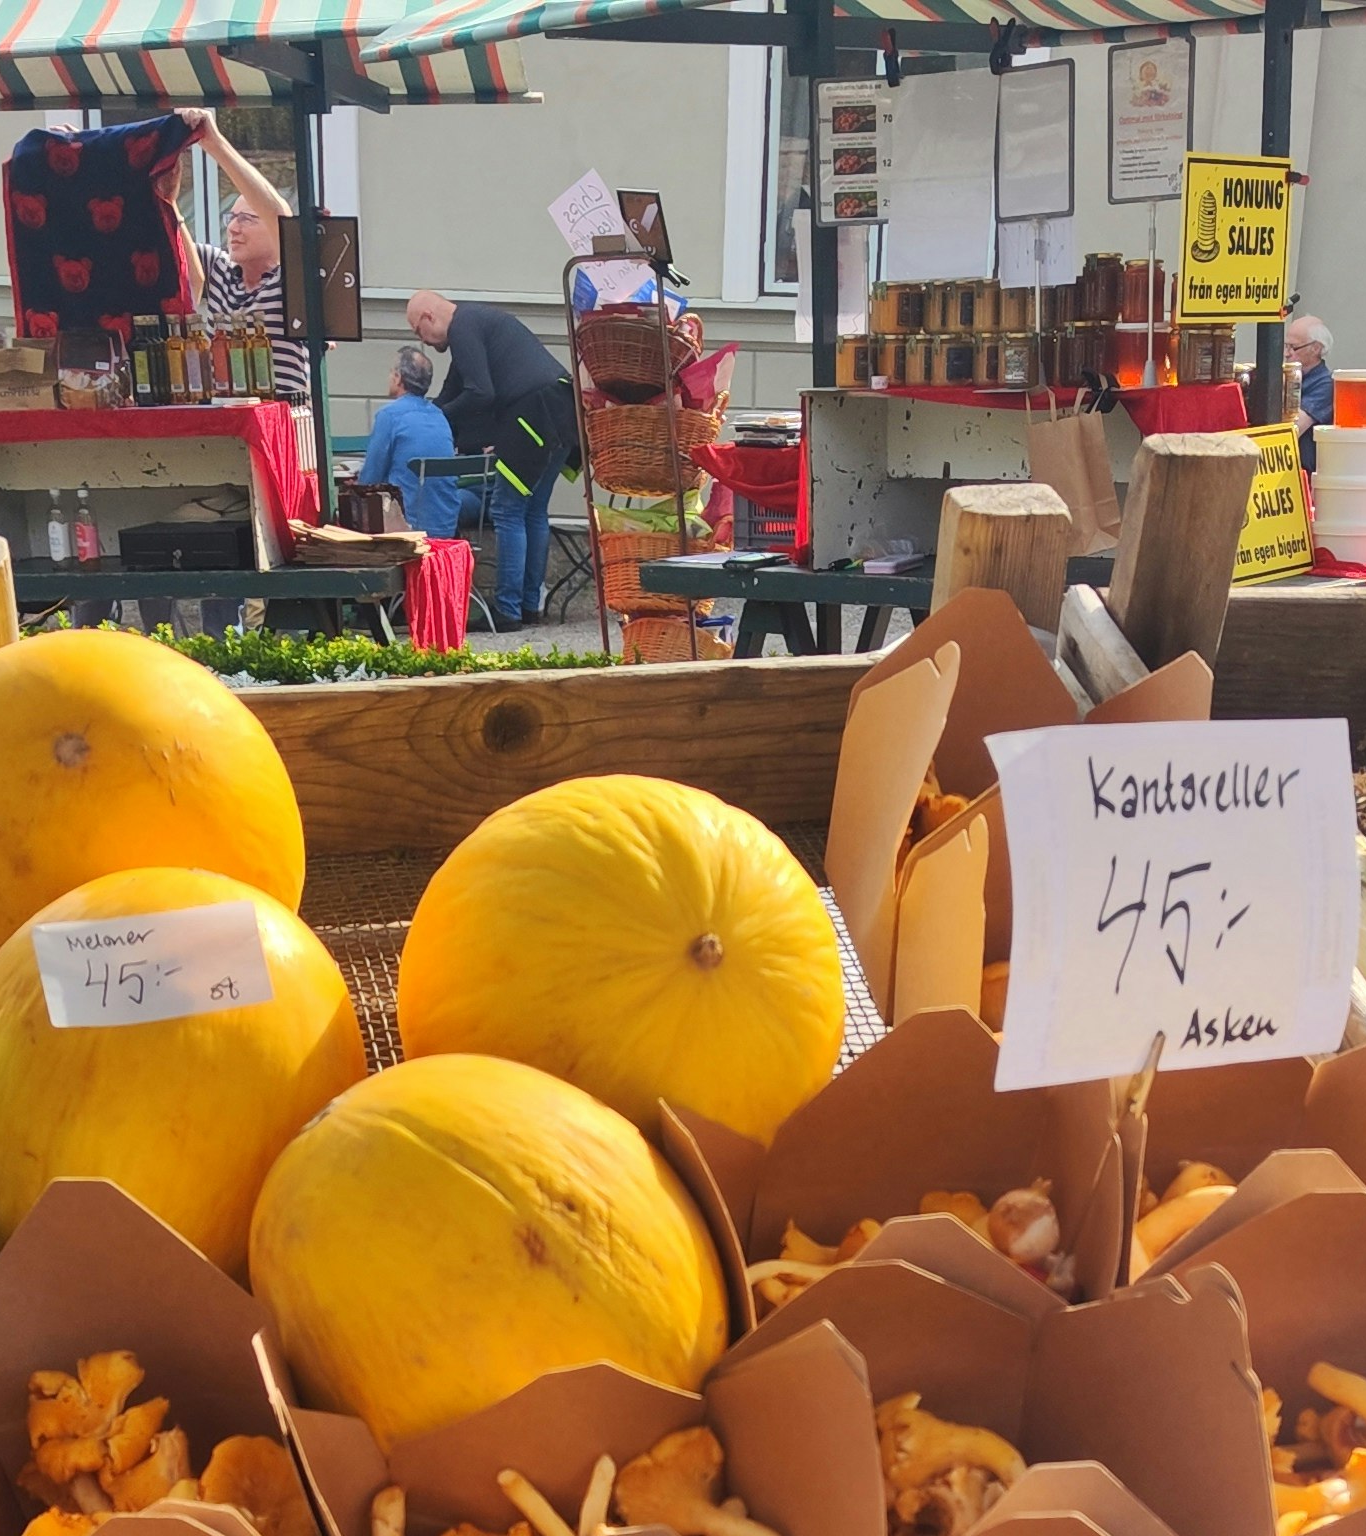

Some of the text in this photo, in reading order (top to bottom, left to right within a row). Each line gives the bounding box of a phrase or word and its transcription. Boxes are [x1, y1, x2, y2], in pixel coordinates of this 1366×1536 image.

[1223, 177, 1284, 210] HONUNG
[1228, 217, 1275, 256] SÄLJES
[1189, 276, 1280, 304] från egen bigård
[1255, 443, 1294, 476] NUNG
[1252, 483, 1294, 519] SÄLJES
[1236, 531, 1307, 565] rån egen bigård
[209, 976, 240, 1000] st
[1180, 1007, 1279, 1049] Asken
